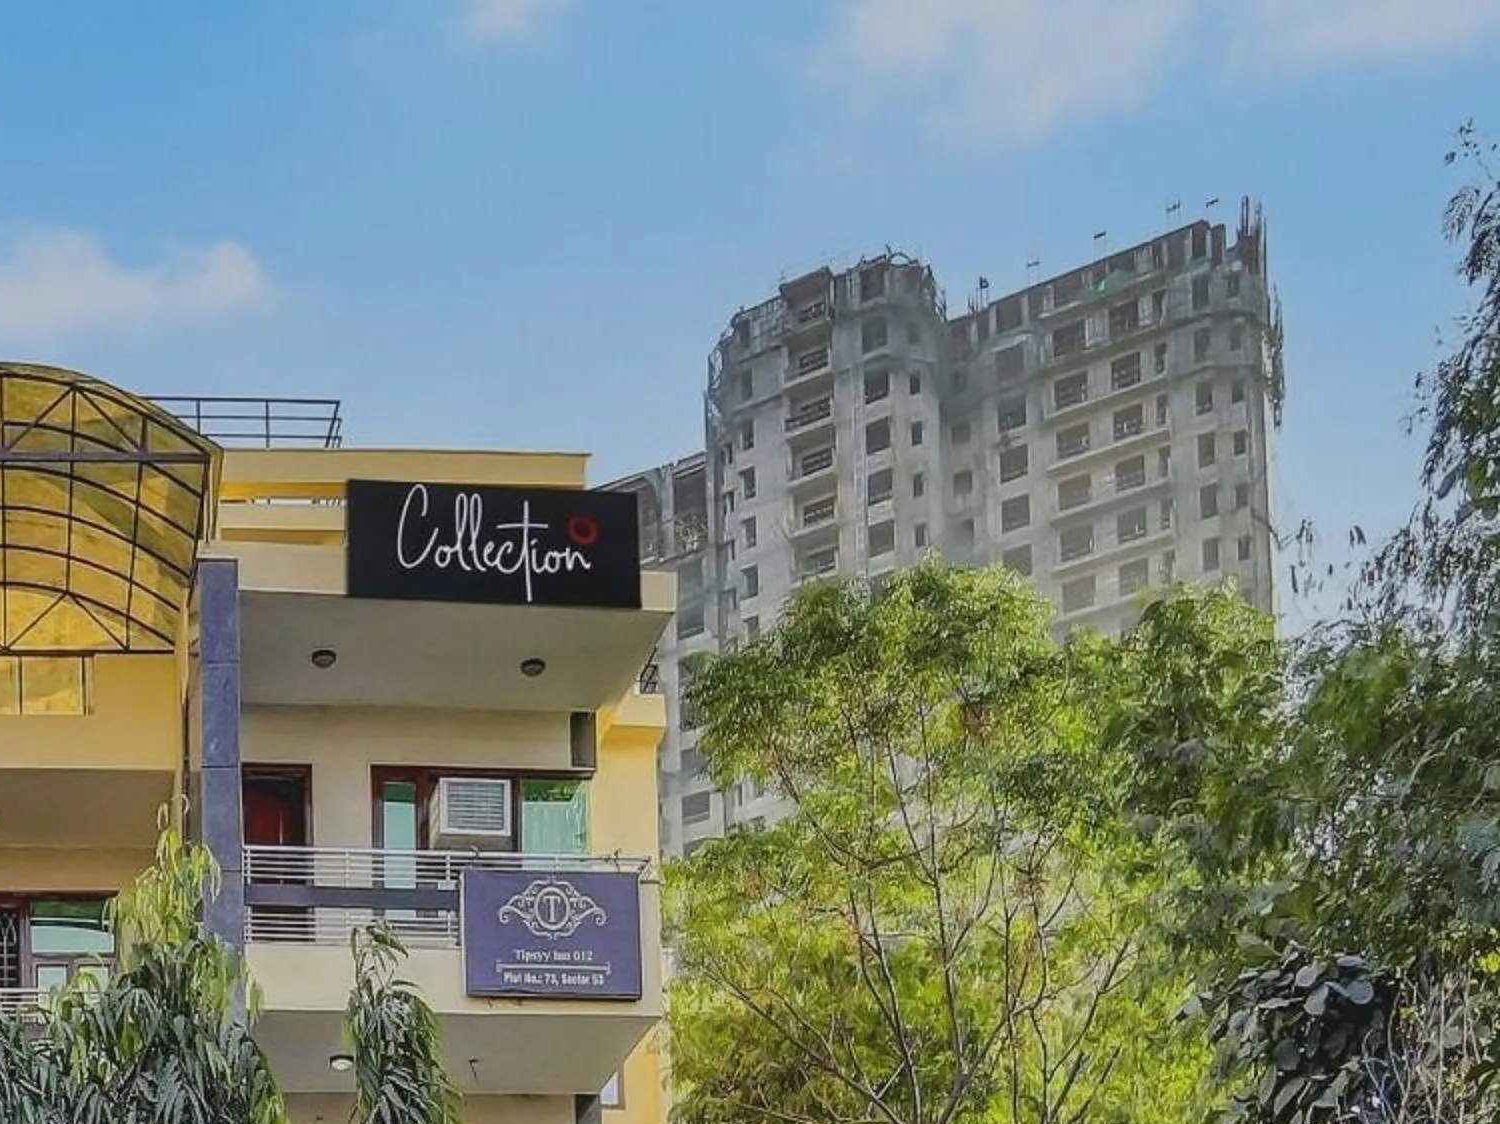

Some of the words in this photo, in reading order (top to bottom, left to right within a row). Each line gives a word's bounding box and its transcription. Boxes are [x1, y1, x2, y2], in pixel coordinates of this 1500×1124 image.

[397, 484, 592, 602] Collection
[513, 949, 551, 963] Tipsyy
[553, 950, 571, 961] Inn
[573, 950, 593, 961] 012
[503, 971, 523, 985] Plot
[561, 973, 591, 985] Sector
